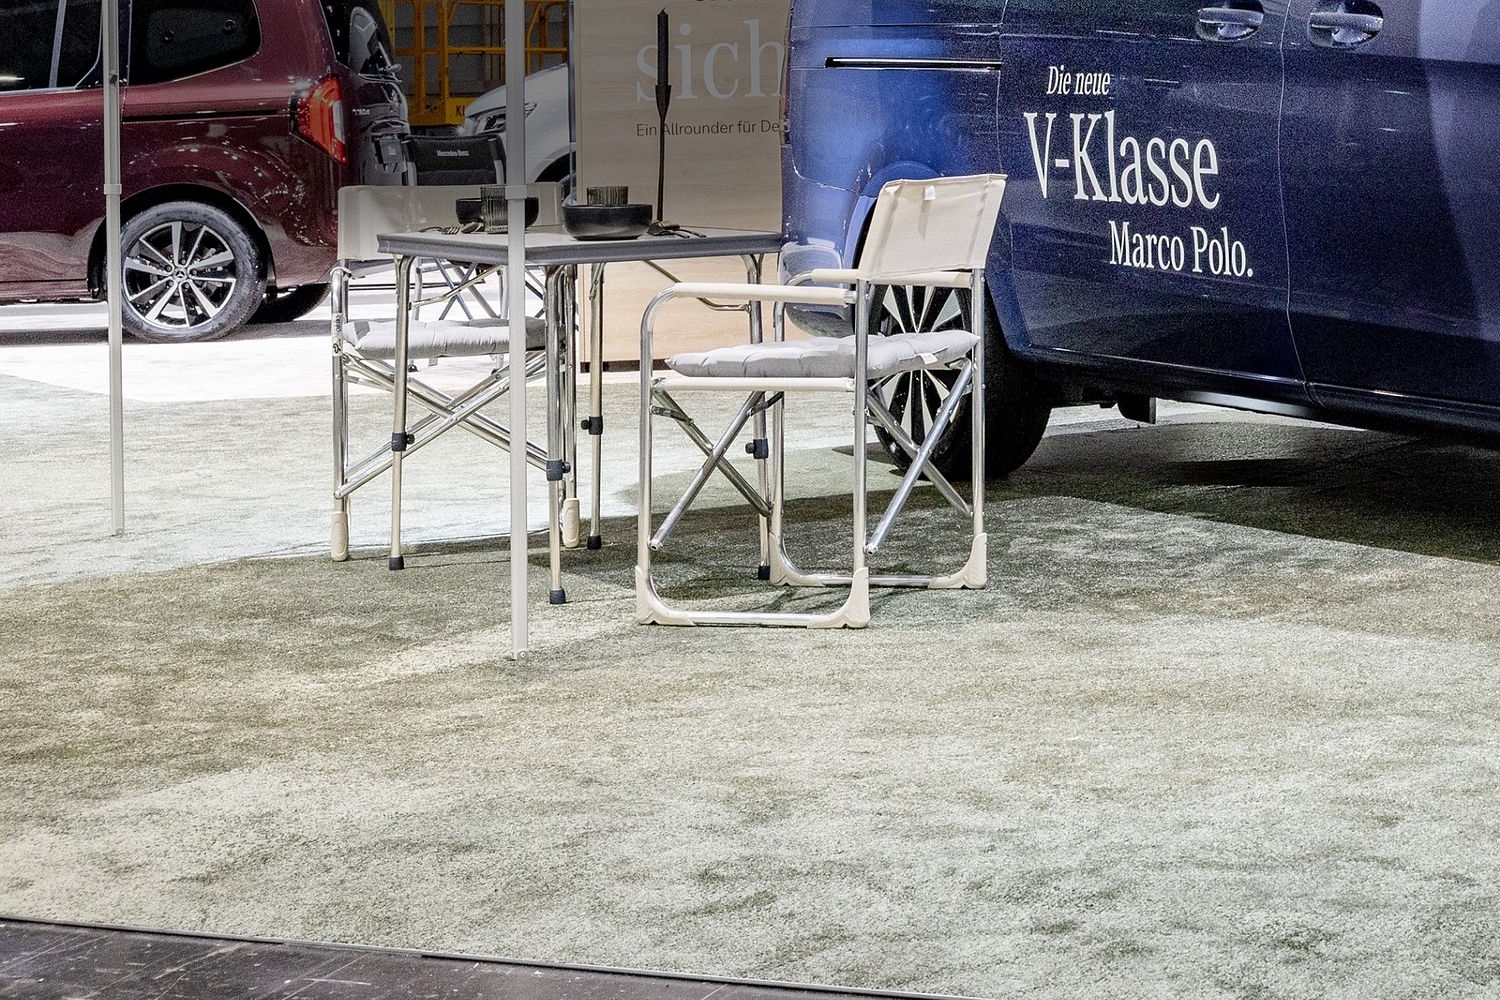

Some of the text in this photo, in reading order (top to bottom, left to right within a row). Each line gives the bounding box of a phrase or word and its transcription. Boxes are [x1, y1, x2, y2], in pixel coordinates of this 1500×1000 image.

[1046, 65, 1110, 96] Die neue
[636, 123, 657, 136] Ein
[662, 120, 733, 135] Allrounder
[737, 119, 757, 134] für
[1023, 110, 1220, 209] V-Klasse
[1109, 220, 1254, 277] Marco Polo.
